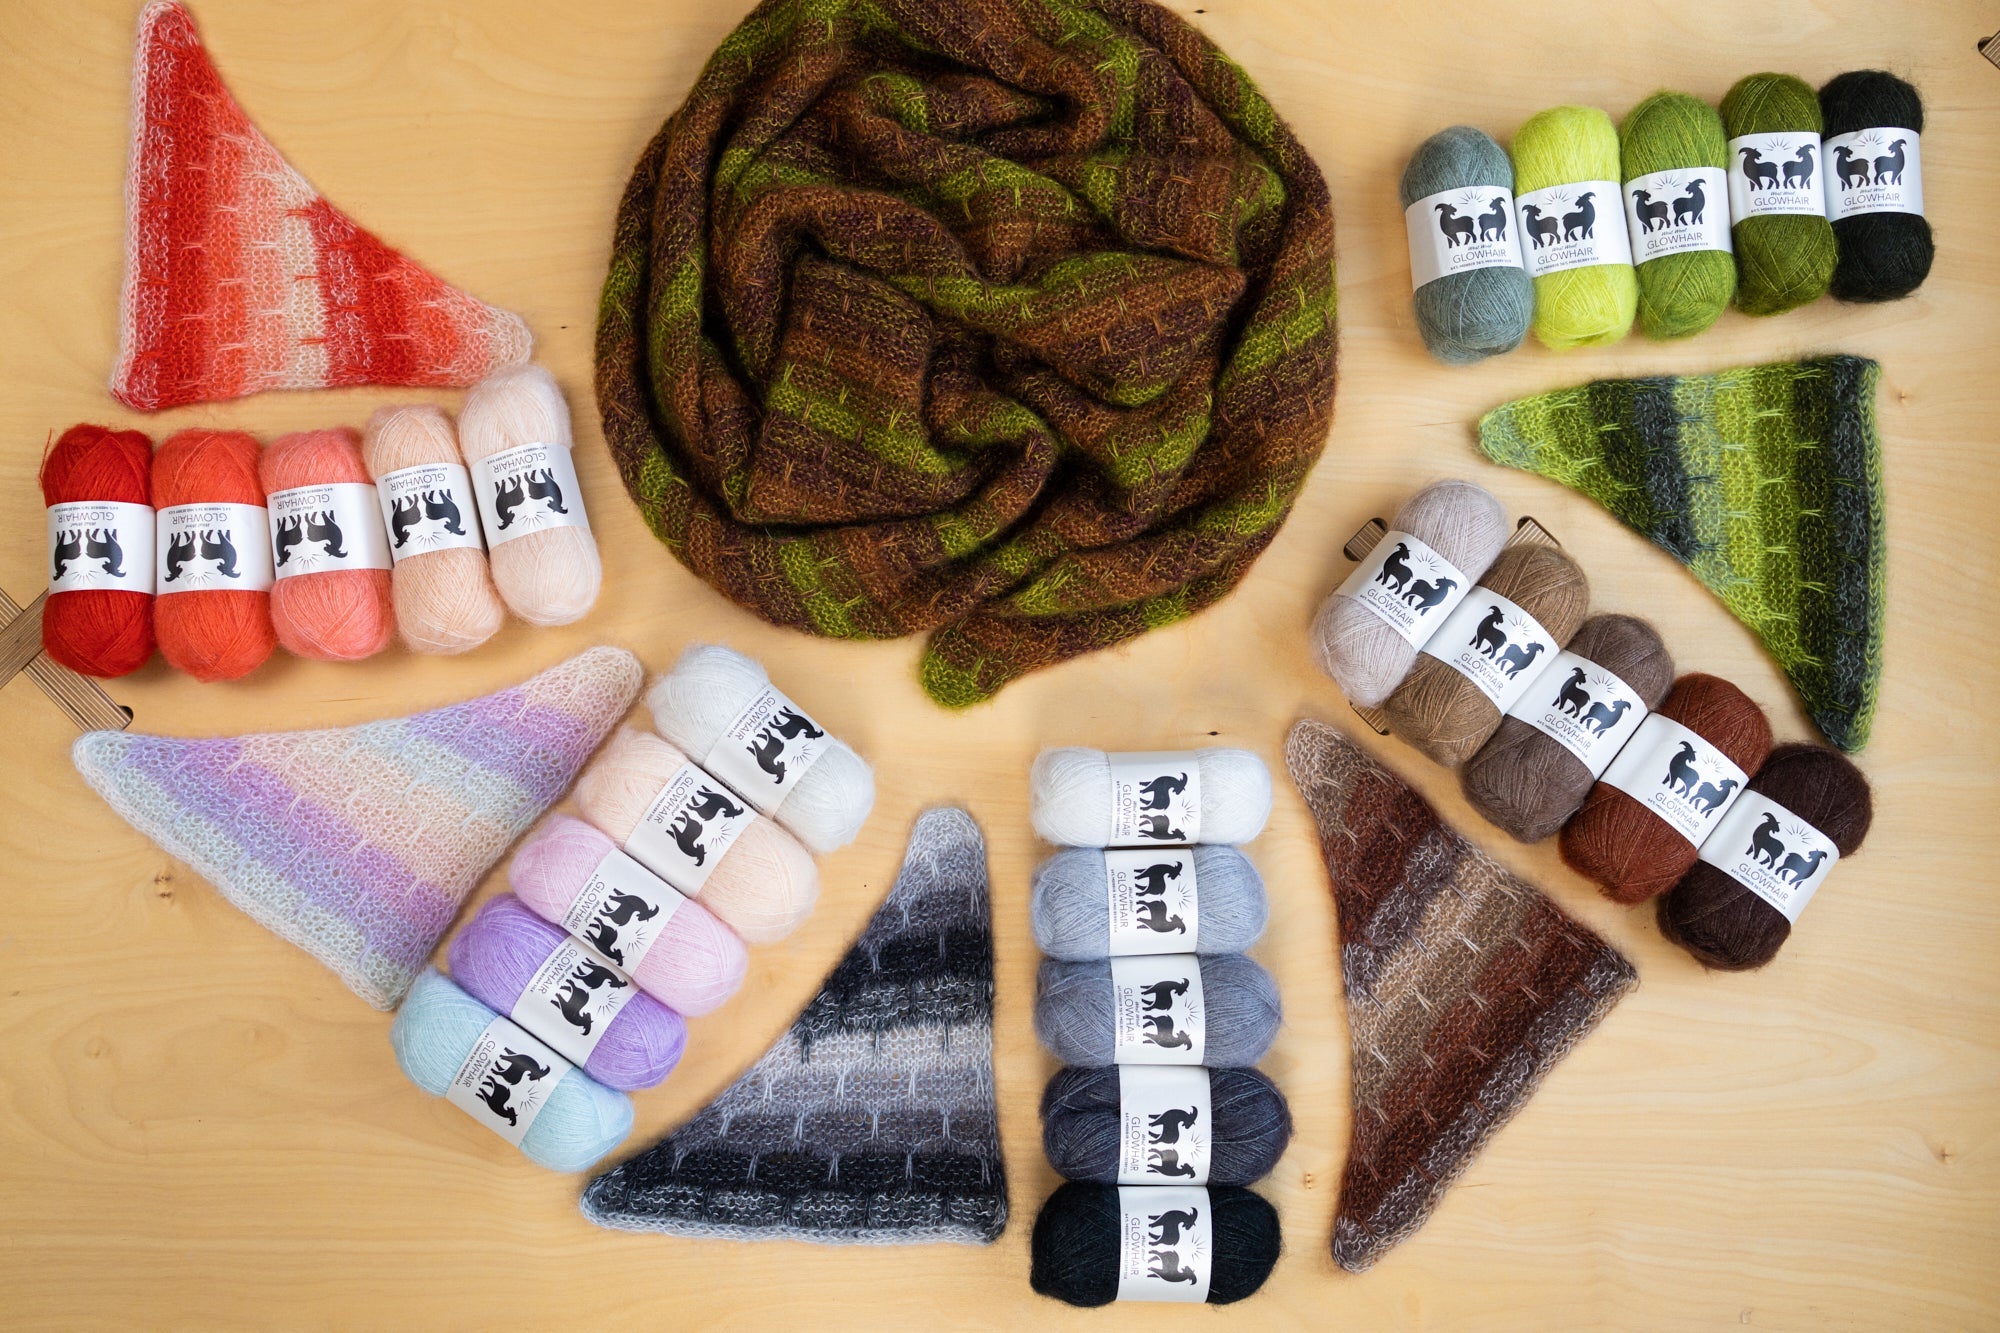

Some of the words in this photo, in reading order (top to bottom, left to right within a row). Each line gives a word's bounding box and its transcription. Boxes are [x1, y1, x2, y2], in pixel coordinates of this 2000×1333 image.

[1754, 196, 1809, 206] GLOWHAIR
[1844, 192, 1899, 206] GLOWHAIR
[1452, 248, 1506, 263] GLOWHAIR
[1537, 246, 1593, 264] GLOWHAIR
[1646, 231, 1703, 249] GLOWHAIR
[389, 472, 445, 491] GLOWHAIR
[492, 451, 546, 473] GLOWHAIR
[57, 511, 114, 522] GLOWHAIR
[172, 512, 227, 524] GLOWHAIR
[276, 493, 329, 509] GLOWHAIR
[1366, 587, 1415, 627] GLOWHAIR
[1459, 651, 1504, 691] GLOWHAIR
[734, 695, 776, 741] GLOWHAIR
[1543, 712, 1592, 750] GLOWHAIR
[653, 775, 694, 824] GLOWHAIR
[1121, 784, 1131, 835] GLOWHAIR
[1653, 790, 1700, 830] GLOWHAIR
[1117, 871, 1128, 927] GLOWHAIR
[1737, 861, 1789, 901] GLOWHAIR
[568, 880, 606, 930] GLOWHAIR
[537, 947, 578, 994] GLOWHAIR
[1123, 987, 1134, 1042] GLOWHAIR
[461, 1039, 496, 1088] GLOWHAIR
[1130, 1116, 1140, 1171] GLOWHAIR
[1130, 1217, 1140, 1275] GLOWHAIR
